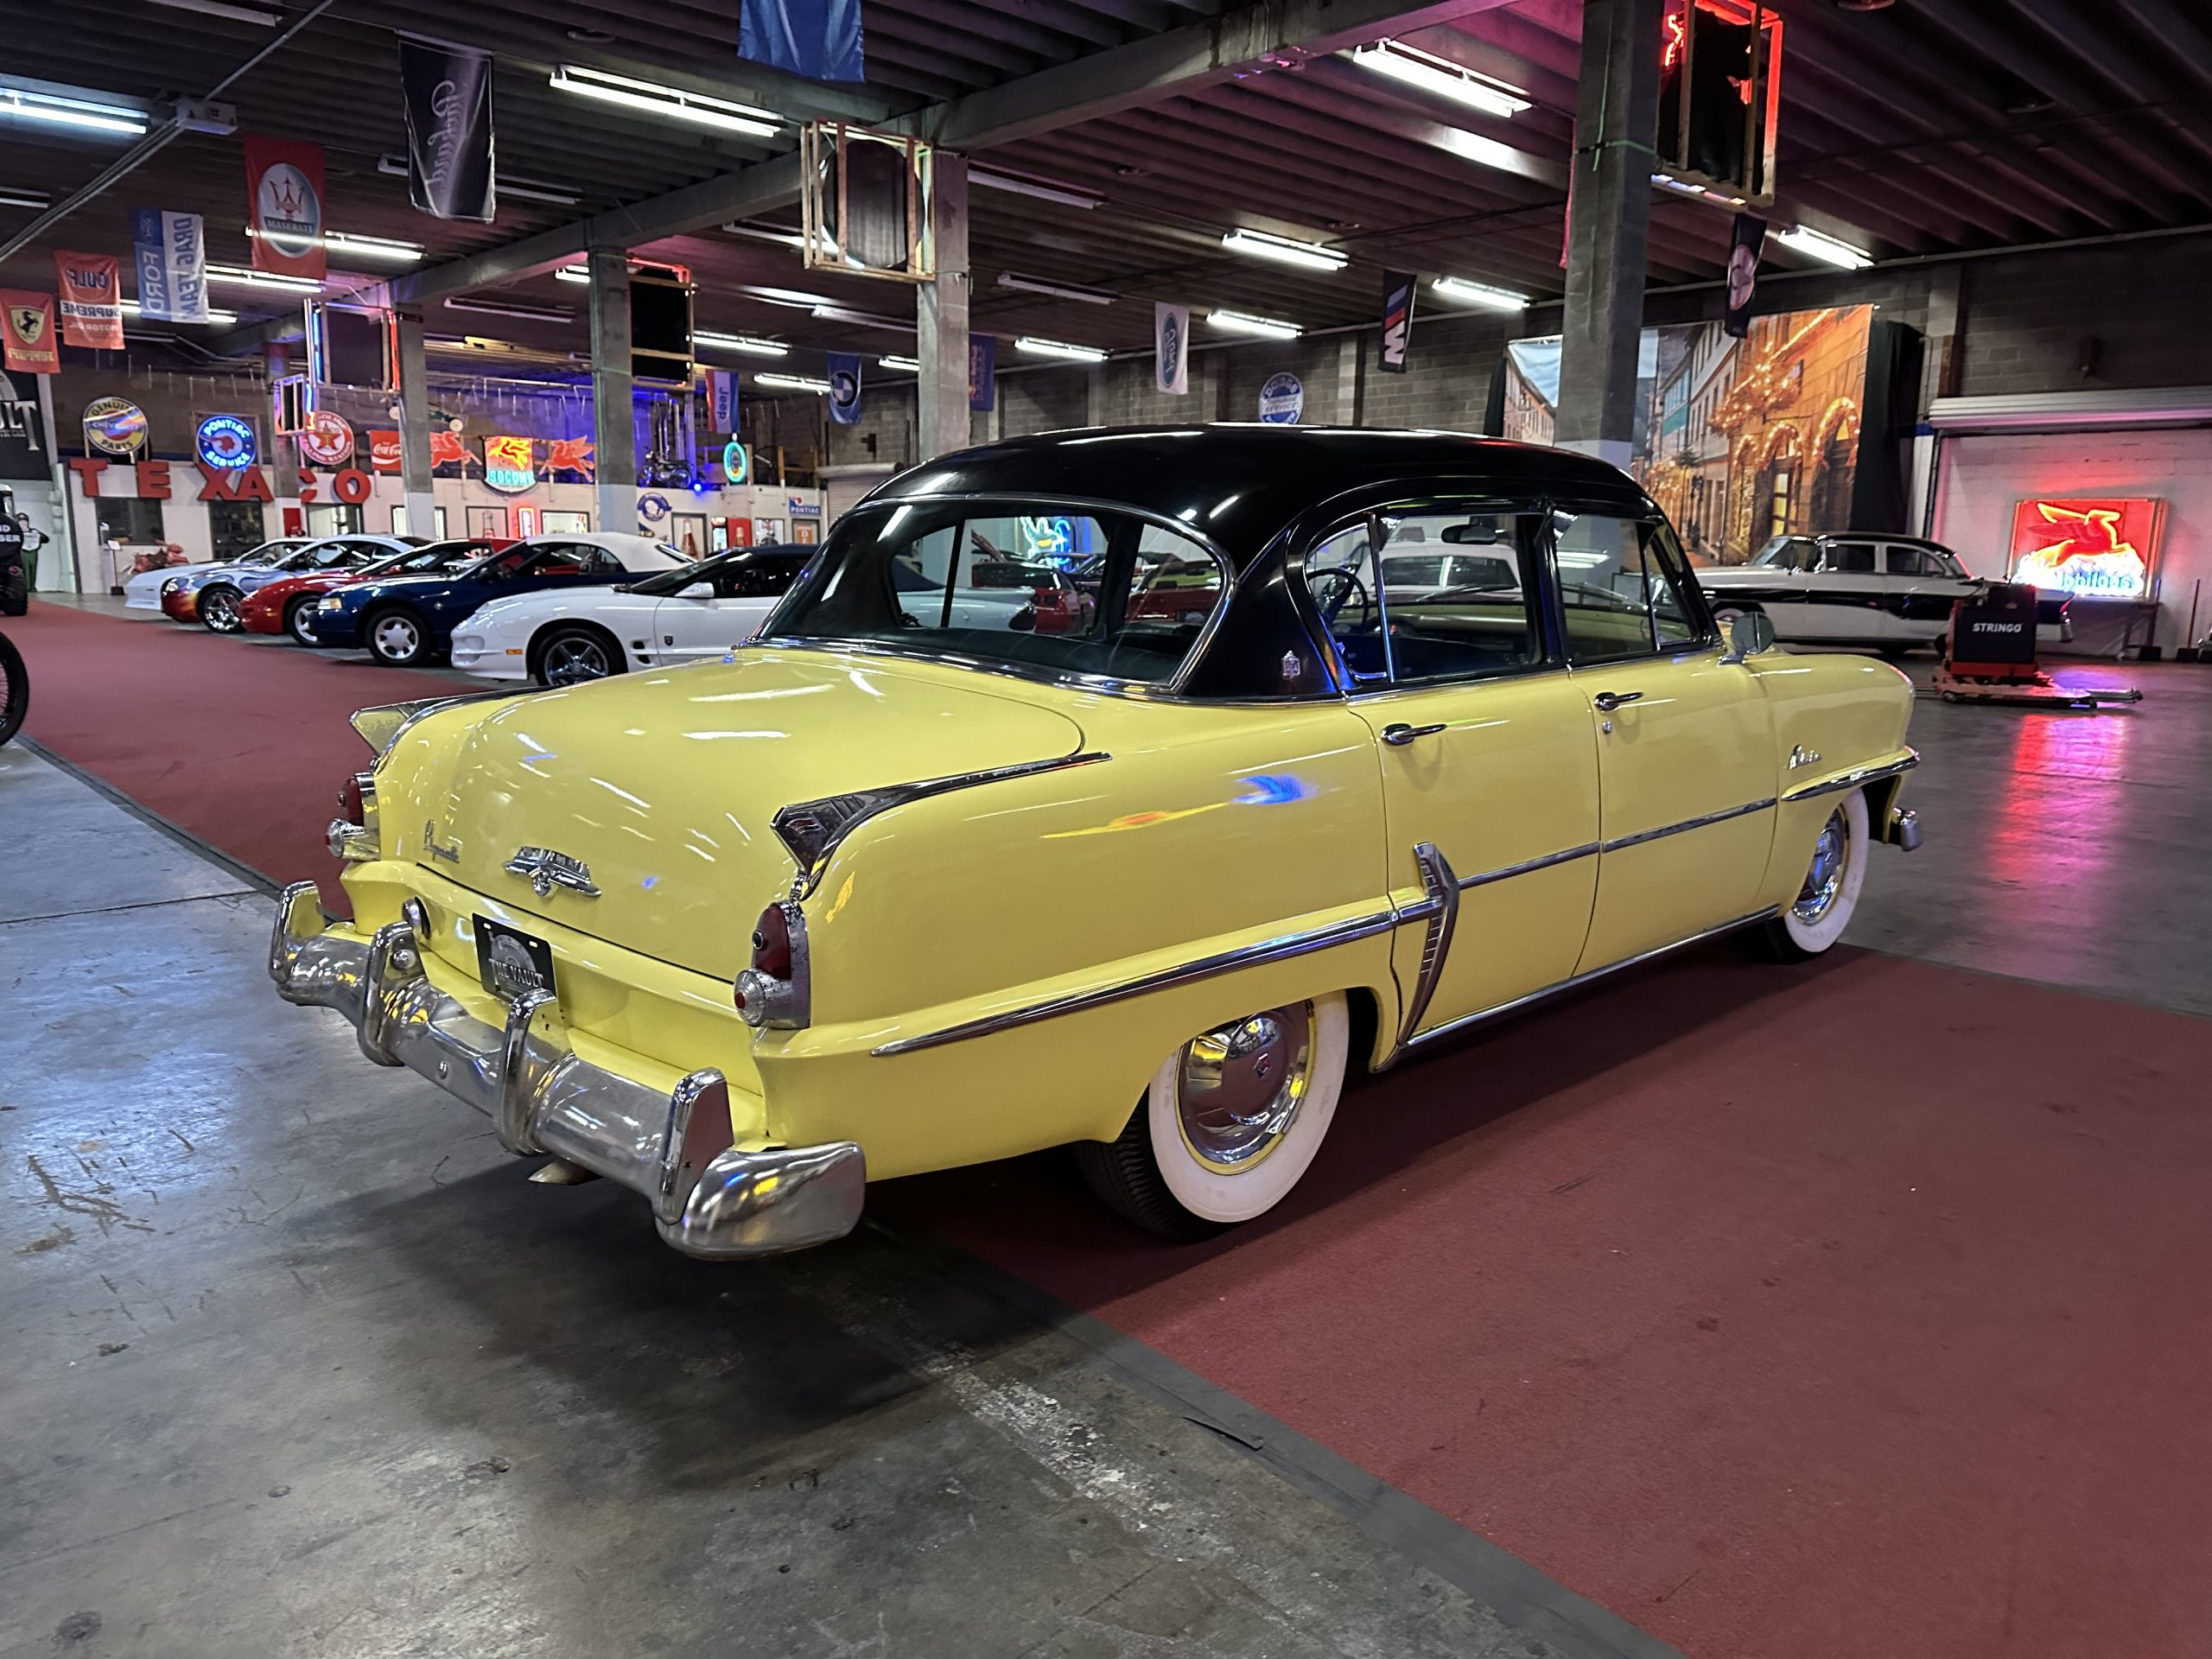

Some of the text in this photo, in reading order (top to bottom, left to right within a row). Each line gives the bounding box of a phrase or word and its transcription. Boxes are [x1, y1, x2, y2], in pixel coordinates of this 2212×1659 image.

[267, 219, 314, 233] MASERATI
[1264, 378, 1299, 397] DODGE
[716, 386, 729, 420] Jeep
[204, 419, 251, 438] PONTIAC
[101, 439, 133, 449] PARTS
[488, 470, 534, 485] SOCONY
[791, 505, 820, 514] PONTIAC
[1973, 623, 2023, 633] STRINGO
[488, 957, 510, 985] THE
[509, 965, 543, 990] VAULT
